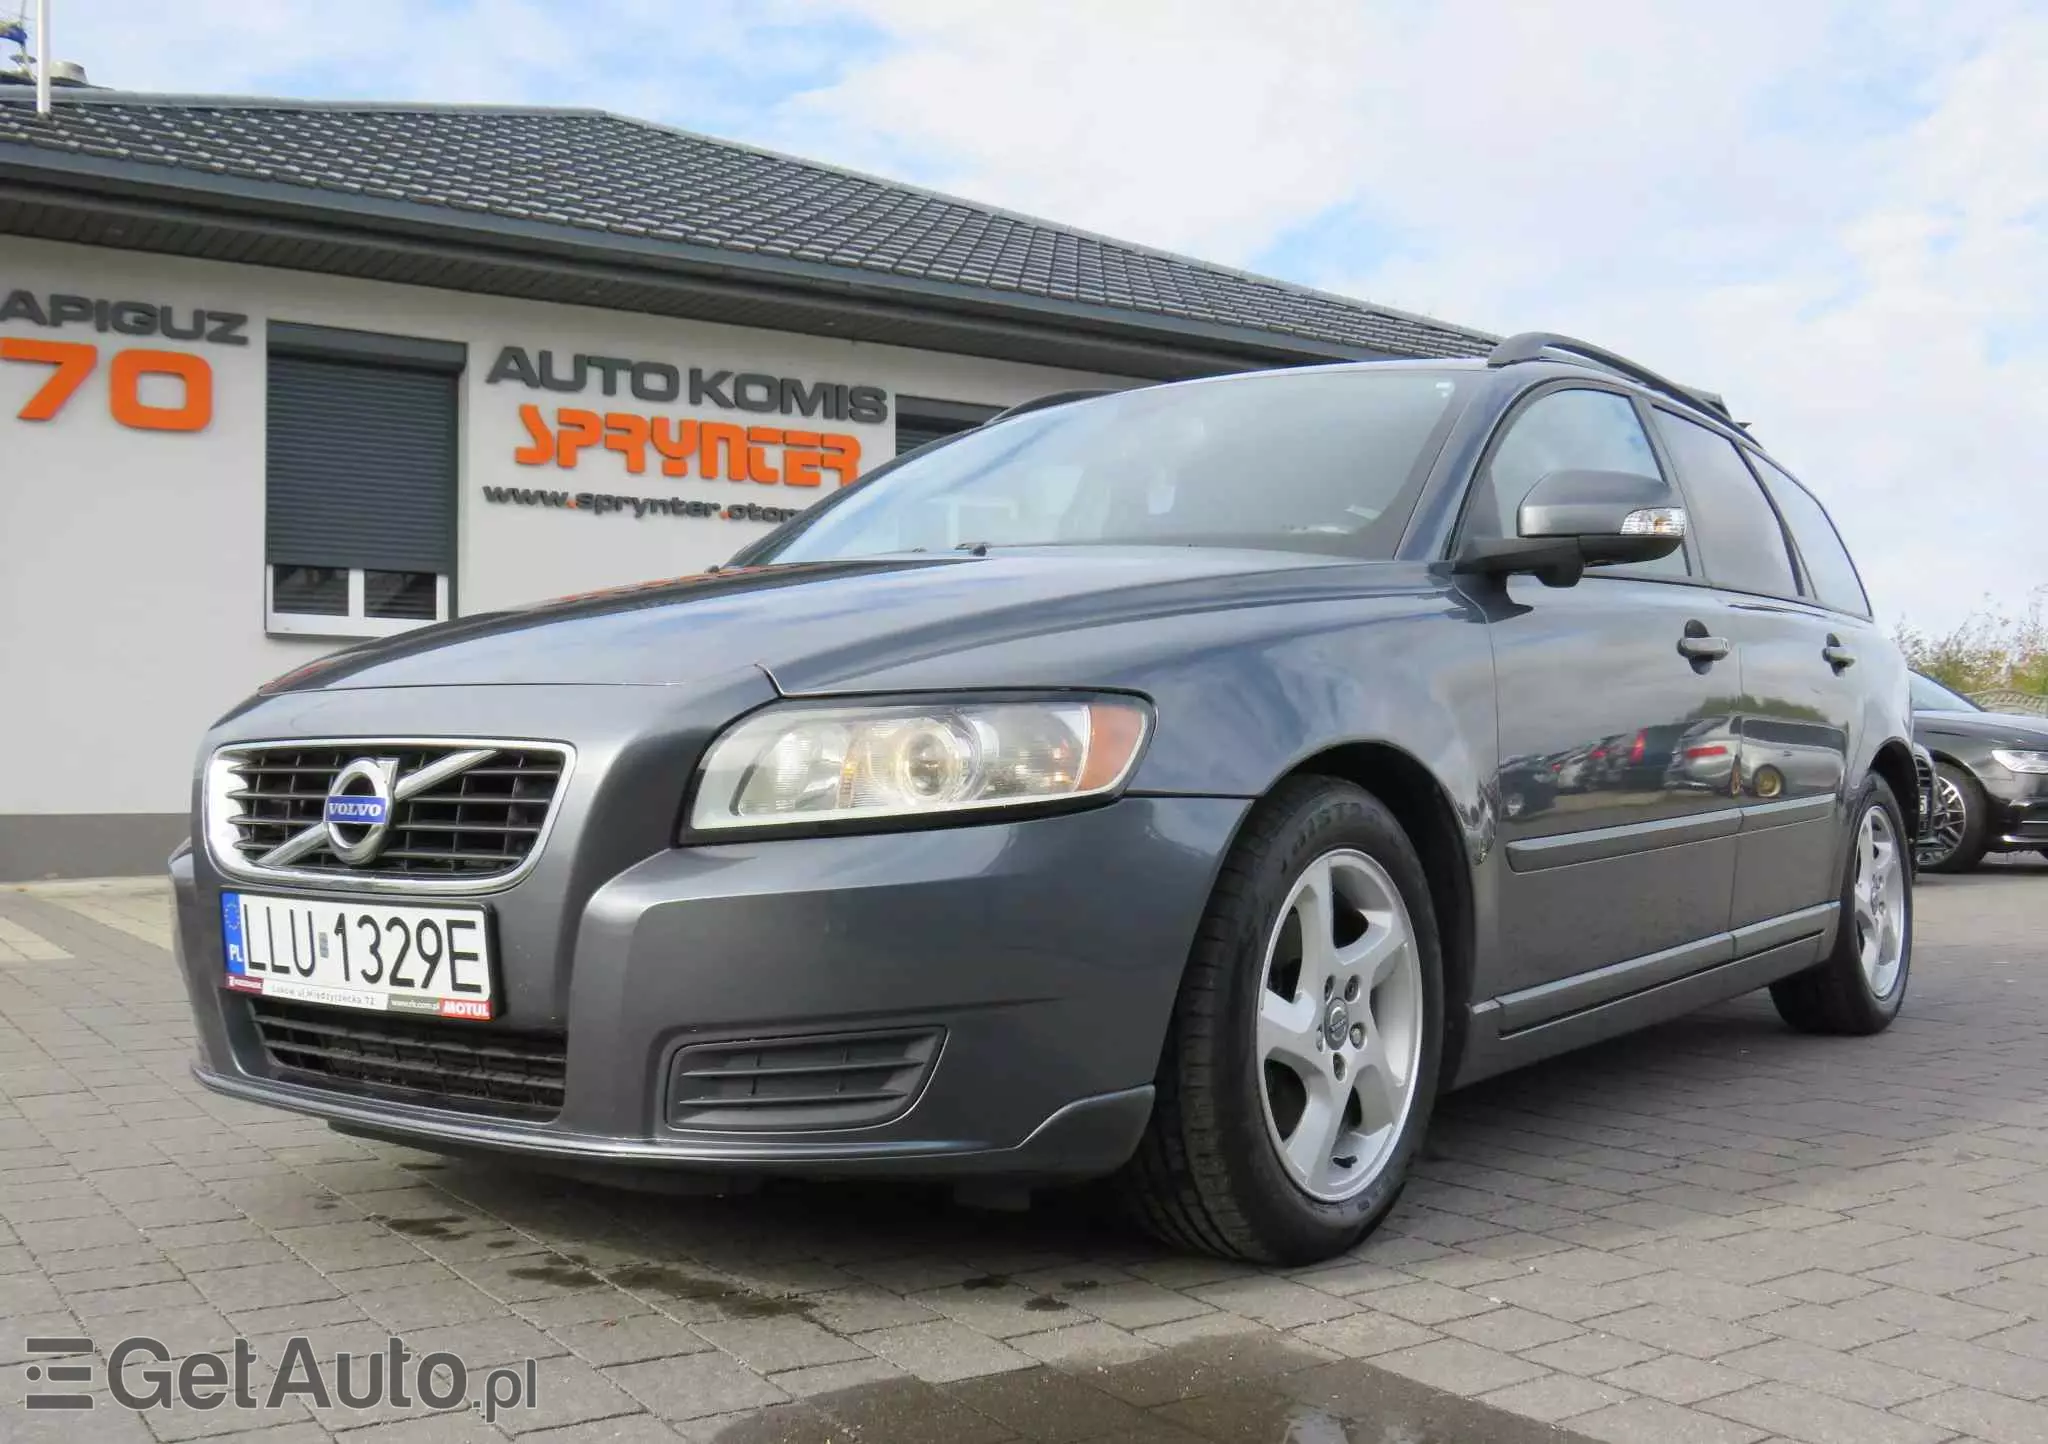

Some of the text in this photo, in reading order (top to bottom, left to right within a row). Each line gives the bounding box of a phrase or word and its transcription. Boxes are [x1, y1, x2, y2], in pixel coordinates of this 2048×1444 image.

[0, 337, 213, 433] 70
[515, 404, 863, 488] SPRYNTER
[328, 802, 382, 817] VOLVO
[229, 943, 244, 962] PL
[244, 903, 482, 994] LLU 1329E
[443, 1000, 490, 1017] MOTUL
